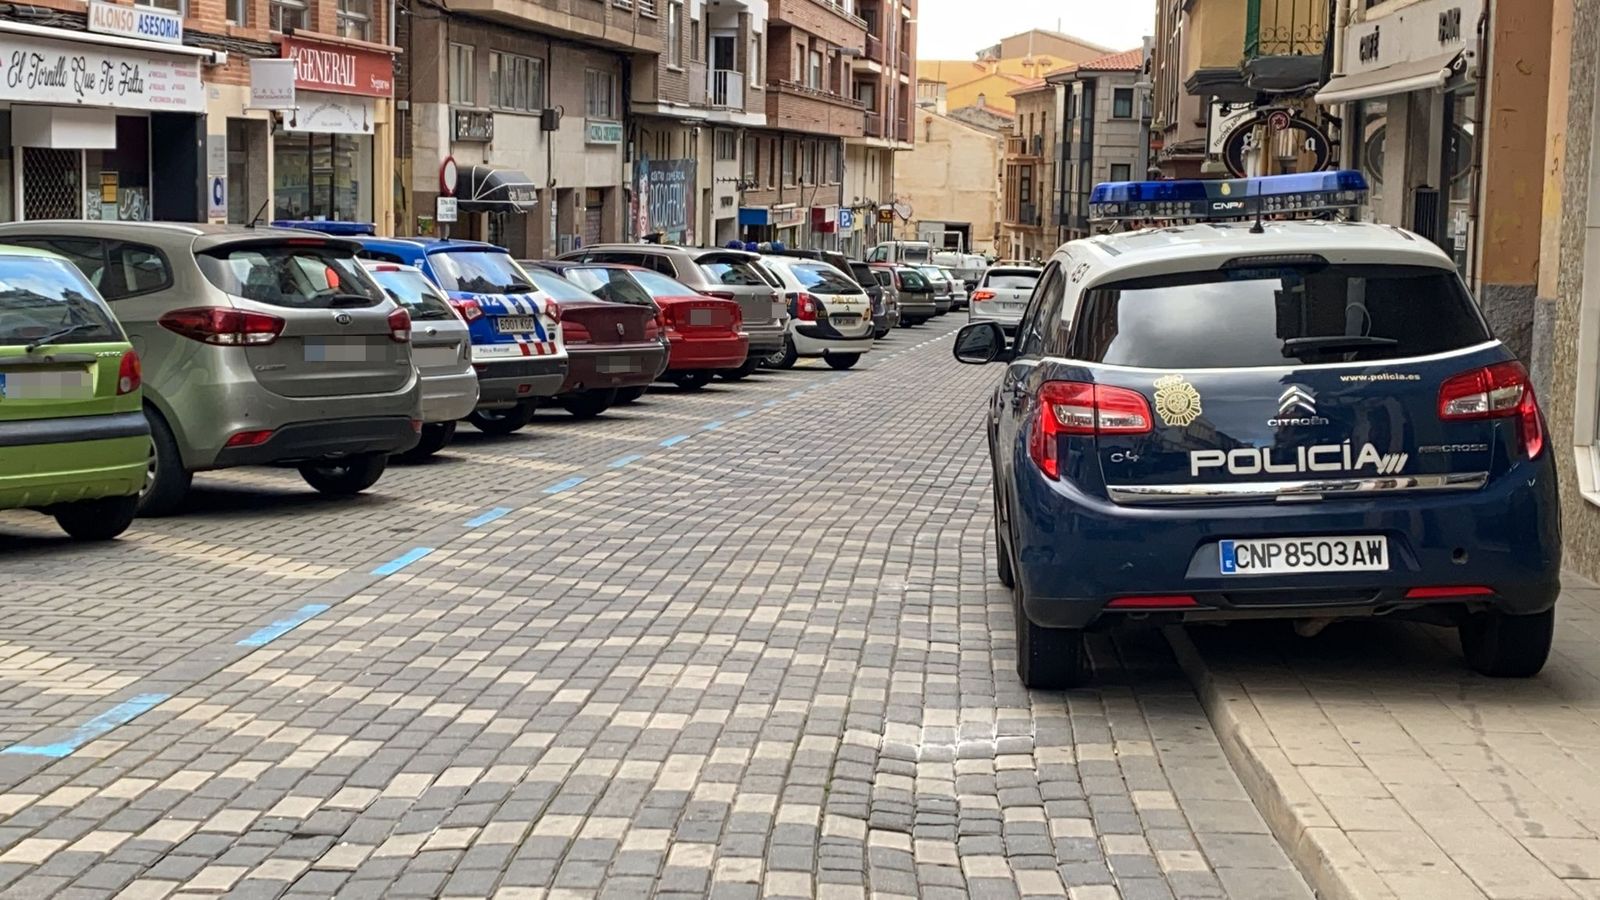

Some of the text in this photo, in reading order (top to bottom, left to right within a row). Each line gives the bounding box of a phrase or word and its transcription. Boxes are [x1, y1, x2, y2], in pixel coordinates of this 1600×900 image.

[93, 6, 180, 39] ALONSO ASESORIA
[1438, 7, 1462, 45] BAR
[7, 50, 144, 97] El Tornillo Que Te Falta
[299, 48, 356, 88] GENERALI
[1213, 202, 1239, 210] CNP
[473, 294, 500, 306] 112
[1339, 373, 1421, 382] www.policia.es
[1110, 450, 1140, 463] C4
[1190, 438, 1386, 477] POLICÍA
